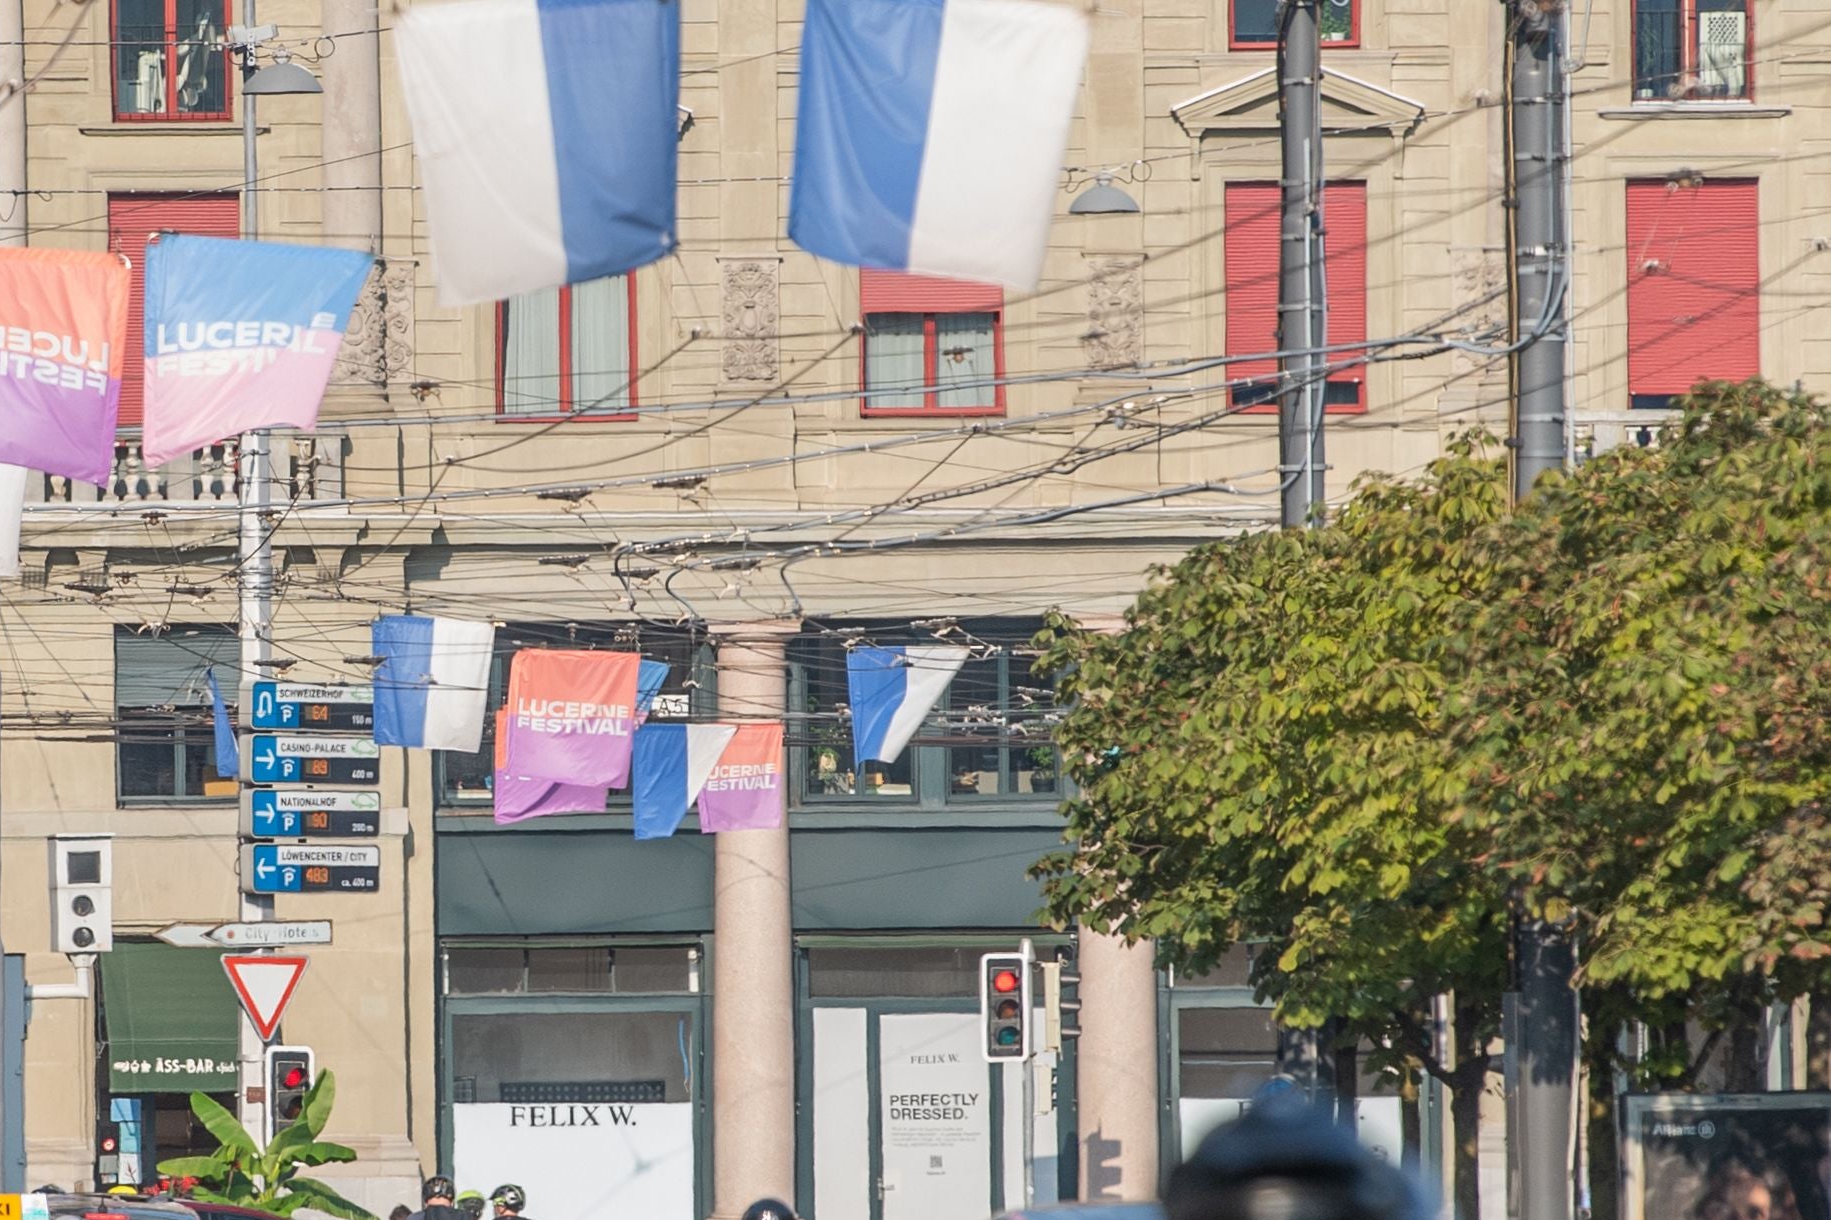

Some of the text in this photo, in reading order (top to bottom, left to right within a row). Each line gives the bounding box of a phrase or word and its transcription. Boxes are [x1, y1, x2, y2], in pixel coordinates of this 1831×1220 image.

[279, 689, 344, 699] SCHWEIZERHOF
[519, 697, 629, 719] LUCERNE
[517, 716, 628, 736] FESTIVAL
[280, 743, 346, 753] CASINO-PALACE
[708, 763, 777, 780] UCERNE
[706, 775, 777, 792] ESTIVAL
[280, 797, 337, 807] NATIONALHOF
[281, 851, 342, 862] LÖWENCENTER
[350, 852, 368, 862] CITY
[155, 1057, 214, 1074] ÄSS-BAR
[910, 1053, 960, 1064] FELIX W.
[889, 1093, 979, 1107] PERFECTLY
[510, 1105, 637, 1127] FELIX W.
[890, 1107, 969, 1121] DRESSED.
